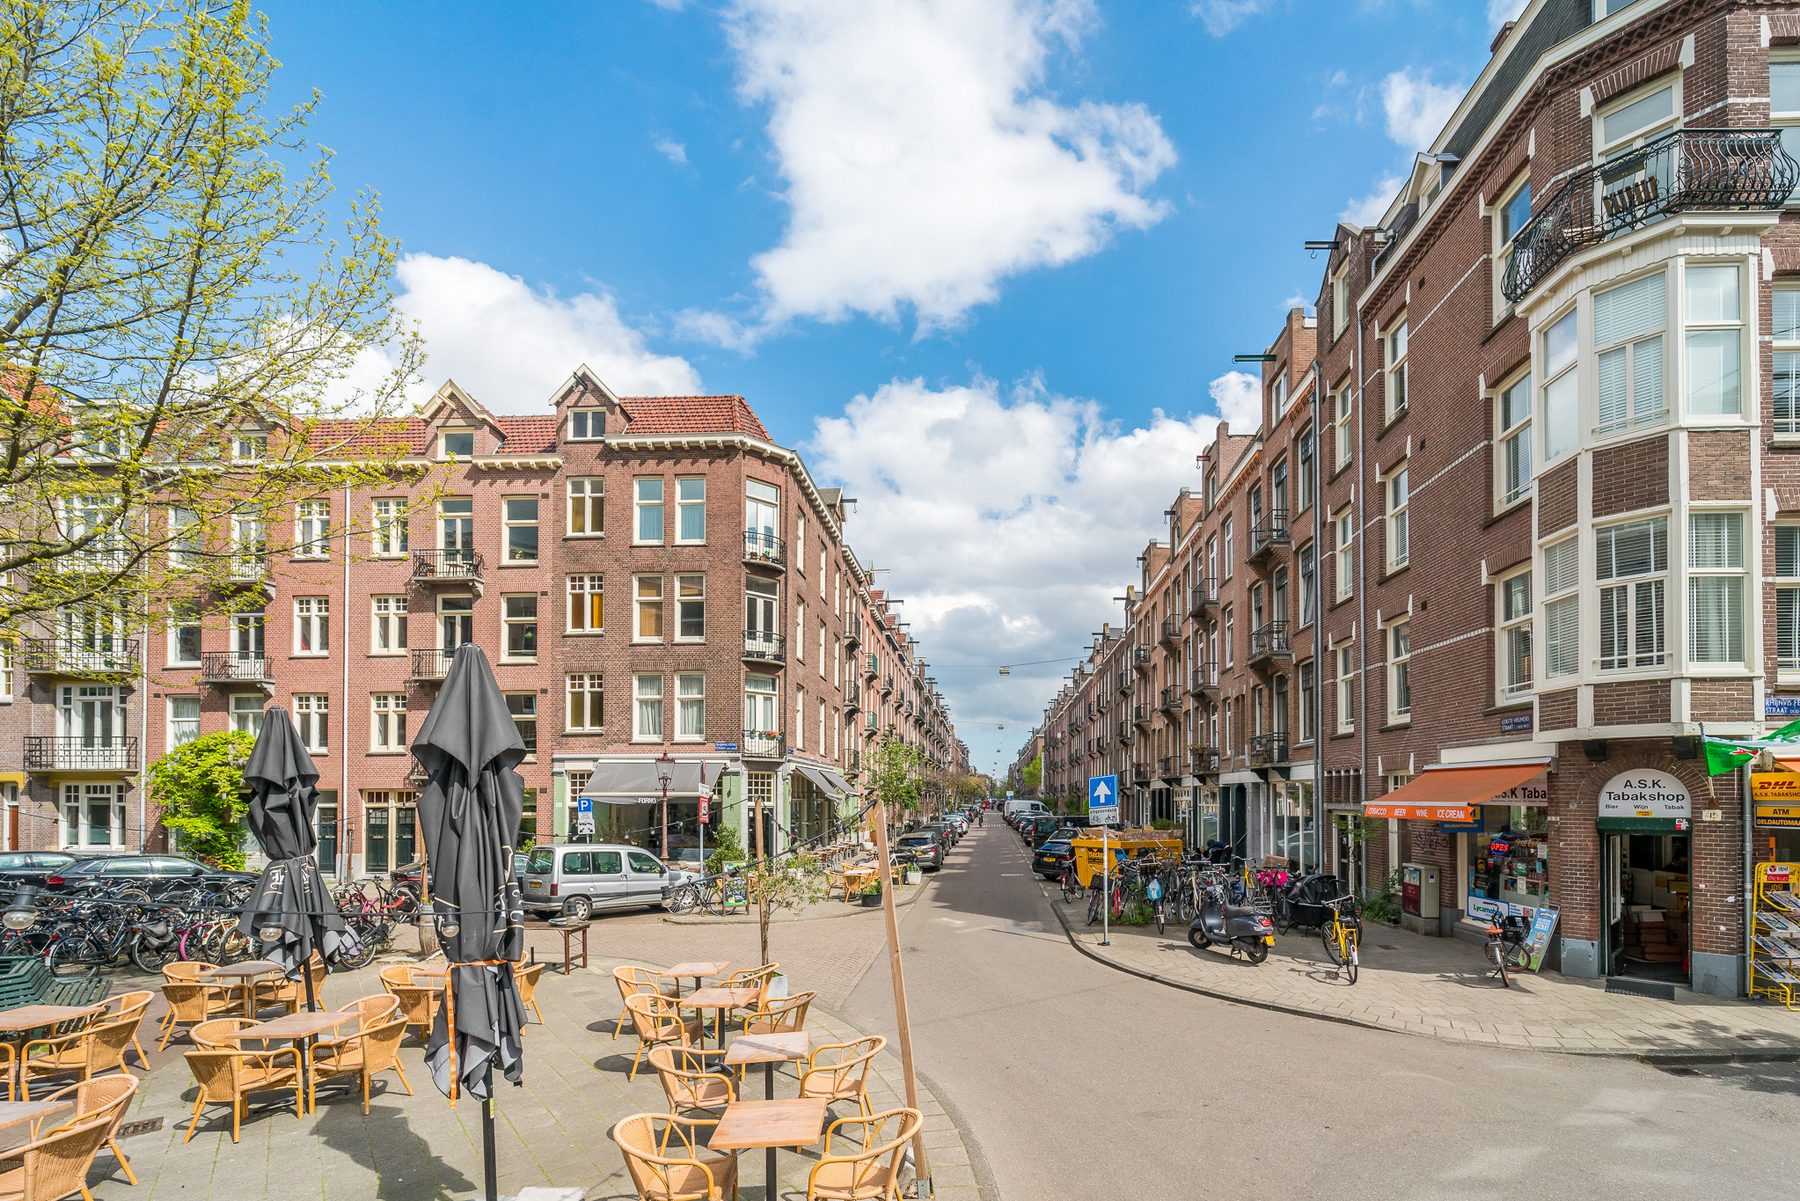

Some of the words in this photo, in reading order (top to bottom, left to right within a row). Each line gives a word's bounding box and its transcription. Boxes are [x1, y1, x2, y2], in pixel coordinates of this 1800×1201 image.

[1623, 779, 1666, 789] A.S.K.
[1758, 781, 1797, 790] DHL
[1521, 787, 1547, 799] Taba
[1606, 791, 1686, 803] Tabakshop
[581, 800, 588, 811] P
[1394, 808, 1406, 816] BEER
[1416, 809, 1428, 817] WINE
[1437, 809, 1446, 818] ICE
[1445, 810, 1464, 818] CREAM
[1490, 842, 1509, 852] OPEN
